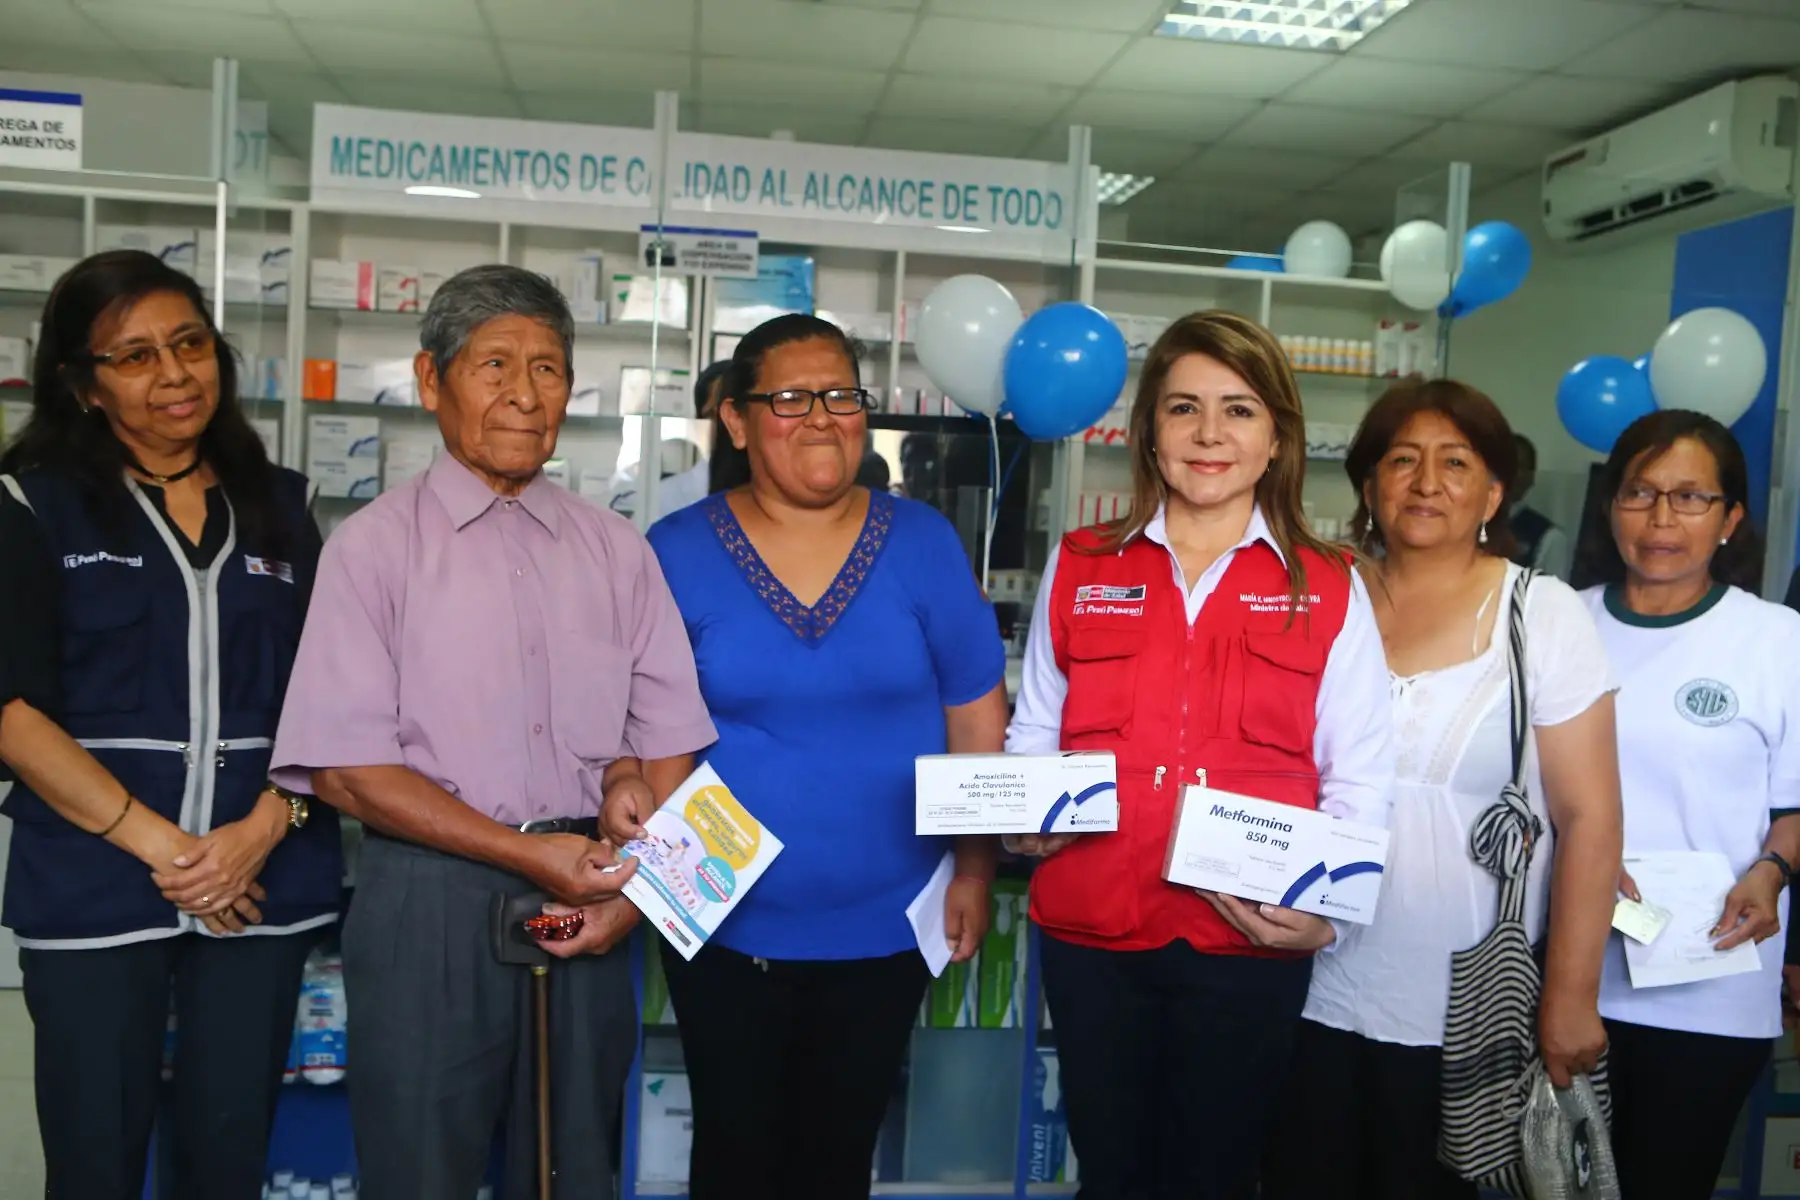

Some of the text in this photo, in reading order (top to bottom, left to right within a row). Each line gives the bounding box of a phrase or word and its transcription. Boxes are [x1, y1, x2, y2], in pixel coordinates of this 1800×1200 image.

[42, 120, 64, 134] DE
[330, 136, 571, 192] MEDICAMENTOS
[579, 153, 618, 194] DE
[626, 156, 751, 203] CIDAD
[759, 167, 794, 207] AL
[803, 171, 934, 219] ALCANCE
[942, 183, 979, 222] DE
[982, 781, 1025, 789] Clavulanico
[1013, 791, 1026, 799] mg
[1209, 804, 1293, 833] Metformina
[1246, 831, 1289, 851] 850 mg
